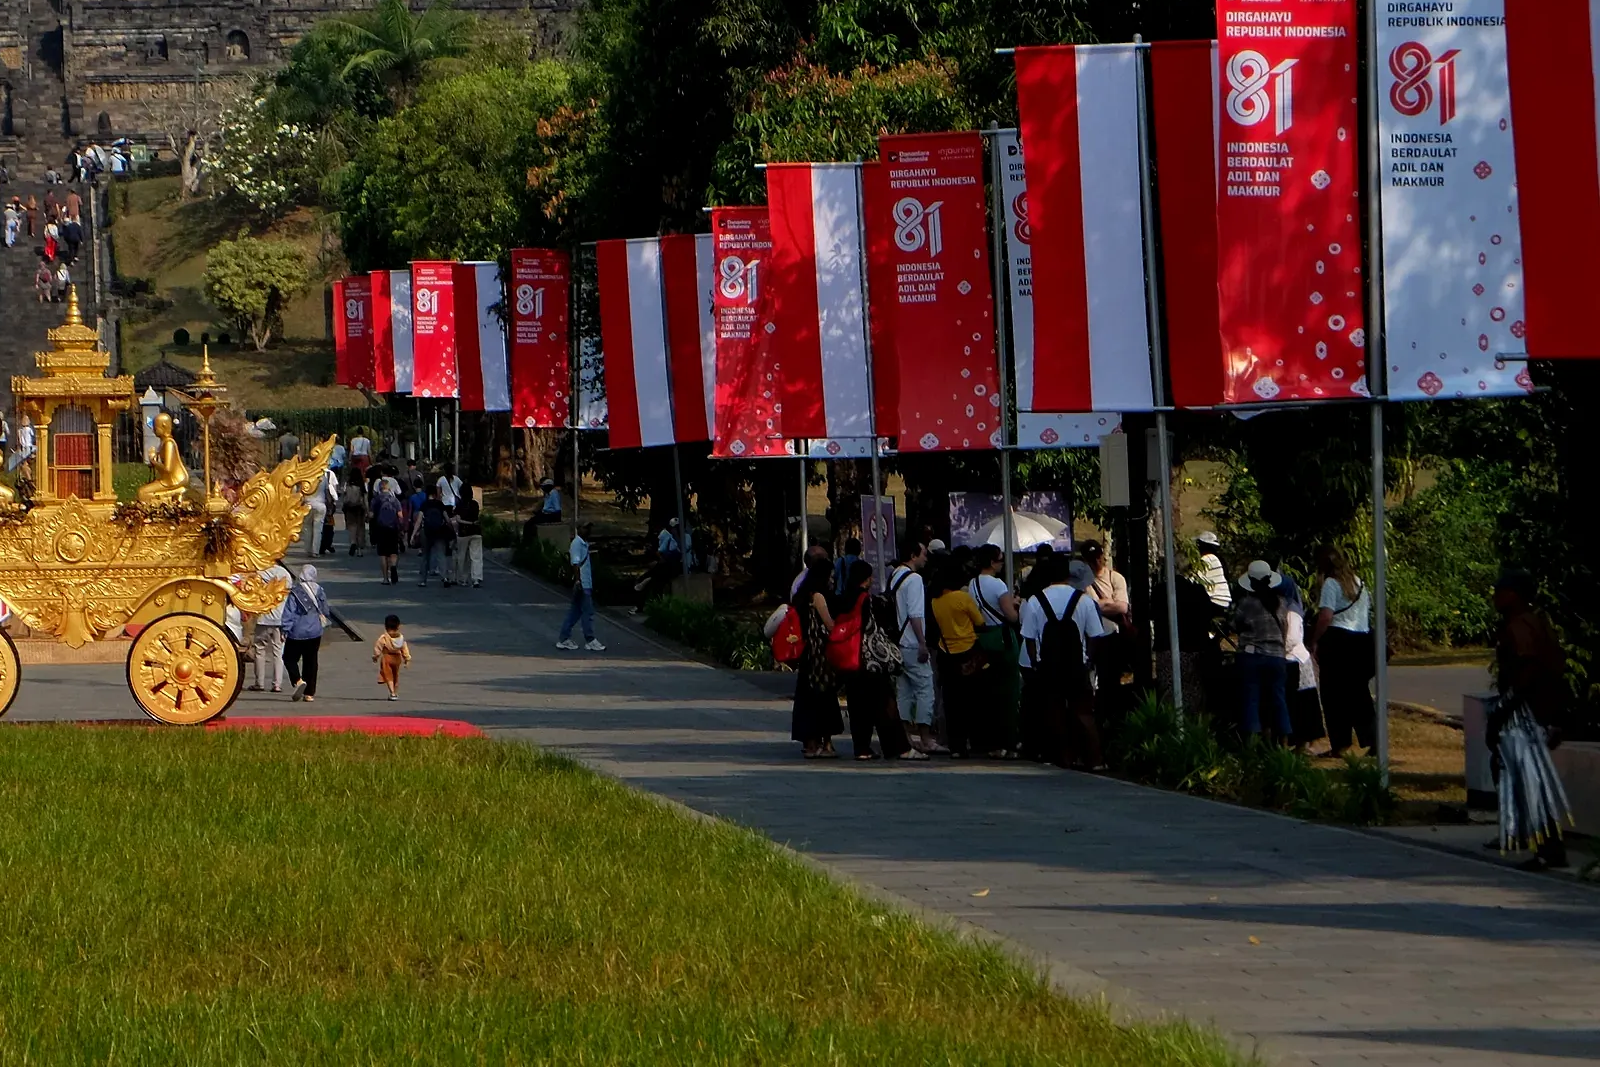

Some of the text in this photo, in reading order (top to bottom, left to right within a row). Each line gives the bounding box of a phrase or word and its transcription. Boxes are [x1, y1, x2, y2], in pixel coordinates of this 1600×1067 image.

[1388, 2, 1453, 12] DIRGAHAYU
[1226, 12, 1292, 22] DIRGAHAYU
[1388, 16, 1506, 27] REPUBLIK INDONESIA
[1226, 26, 1346, 37] REPUBLIK INDONESIA
[1389, 41, 1462, 126] 81
[1226, 50, 1300, 137] 81
[1391, 133, 1452, 144] INDONESIA
[1227, 142, 1289, 153] INDONESIA
[1392, 148, 1458, 158] BERDAULAT
[1227, 157, 1294, 168] BERDAULAT
[1392, 162, 1444, 172] ADIL DAN
[890, 168, 936, 178] DIRGAHAYU
[1227, 172, 1280, 182] ADIL DAN
[890, 176, 976, 188] REPUBLIK INDONESIA
[1392, 177, 1444, 187] MAKMUR
[1227, 186, 1280, 196] MAKMUR
[892, 196, 944, 258] 81
[896, 262, 941, 272] INDONESIA
[720, 255, 760, 304] 81
[897, 272, 944, 283] BERDAULAT
[898, 283, 936, 293] ADIL DAN
[416, 288, 439, 315] 81
[516, 284, 545, 319] 81
[899, 294, 937, 303] MAKMUR
[346, 298, 364, 321] 81
